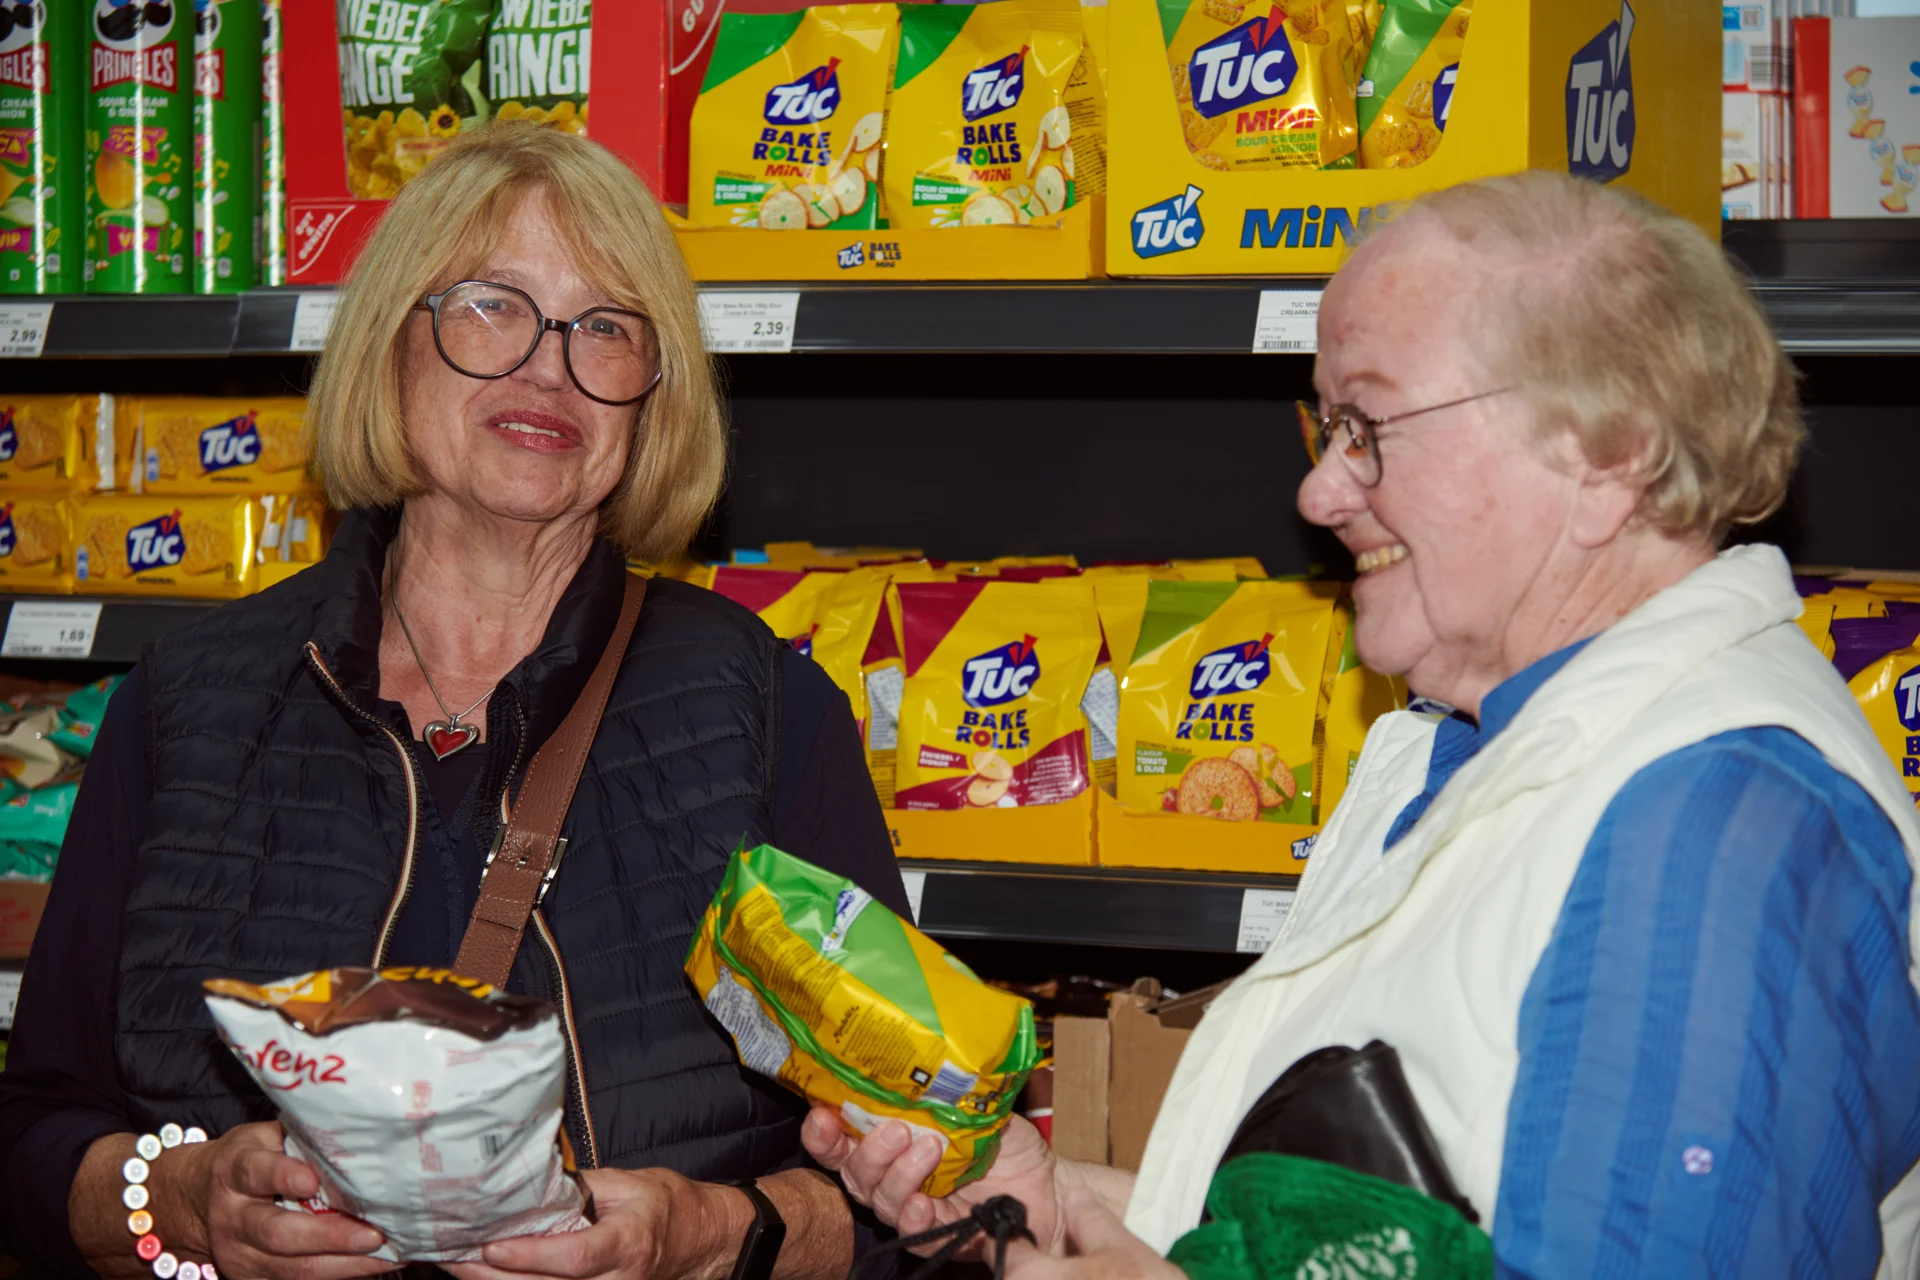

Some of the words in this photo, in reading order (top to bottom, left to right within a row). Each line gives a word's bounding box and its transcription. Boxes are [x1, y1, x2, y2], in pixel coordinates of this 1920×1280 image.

[0, 48, 46, 88] GLES
[93, 46, 174, 87] PRINGLES
[1195, 41, 1285, 102] TUC
[768, 83, 836, 120] TUC
[966, 69, 1020, 112] TUC
[1571, 60, 1628, 168] TUC
[760, 127, 831, 149] BAKE
[963, 122, 1016, 145] BAKE
[1236, 136, 1268, 147] SOUR
[1271, 133, 1317, 144] CREAM
[753, 143, 832, 166] ROLLS
[956, 143, 1021, 165] ROLLS
[1277, 143, 1317, 153] ONION
[915, 185, 937, 193] SOUR
[938, 186, 968, 194] CREAM
[922, 193, 948, 201] ONION
[1136, 210, 1197, 248] TUC
[839, 249, 863, 266] TUC
[869, 250, 901, 260] ROLLS
[870, 242, 899, 251] BAKE
[10, 329, 37, 343] 2,99
[753, 321, 783, 336] 2,39
[201, 428, 255, 464] TUC
[129, 526, 180, 564] TUC
[966, 657, 1035, 699] TUC
[1193, 653, 1263, 691] TUC
[963, 709, 1027, 731] BAKE
[1186, 703, 1254, 721] BAKE
[956, 726, 1030, 749] ROLLS
[1176, 722, 1254, 742] ROLLS
[1137, 749, 1162, 757] FLAVOUR
[1137, 757, 1167, 765] TOMATO
[1144, 765, 1165, 773] OLIVE
